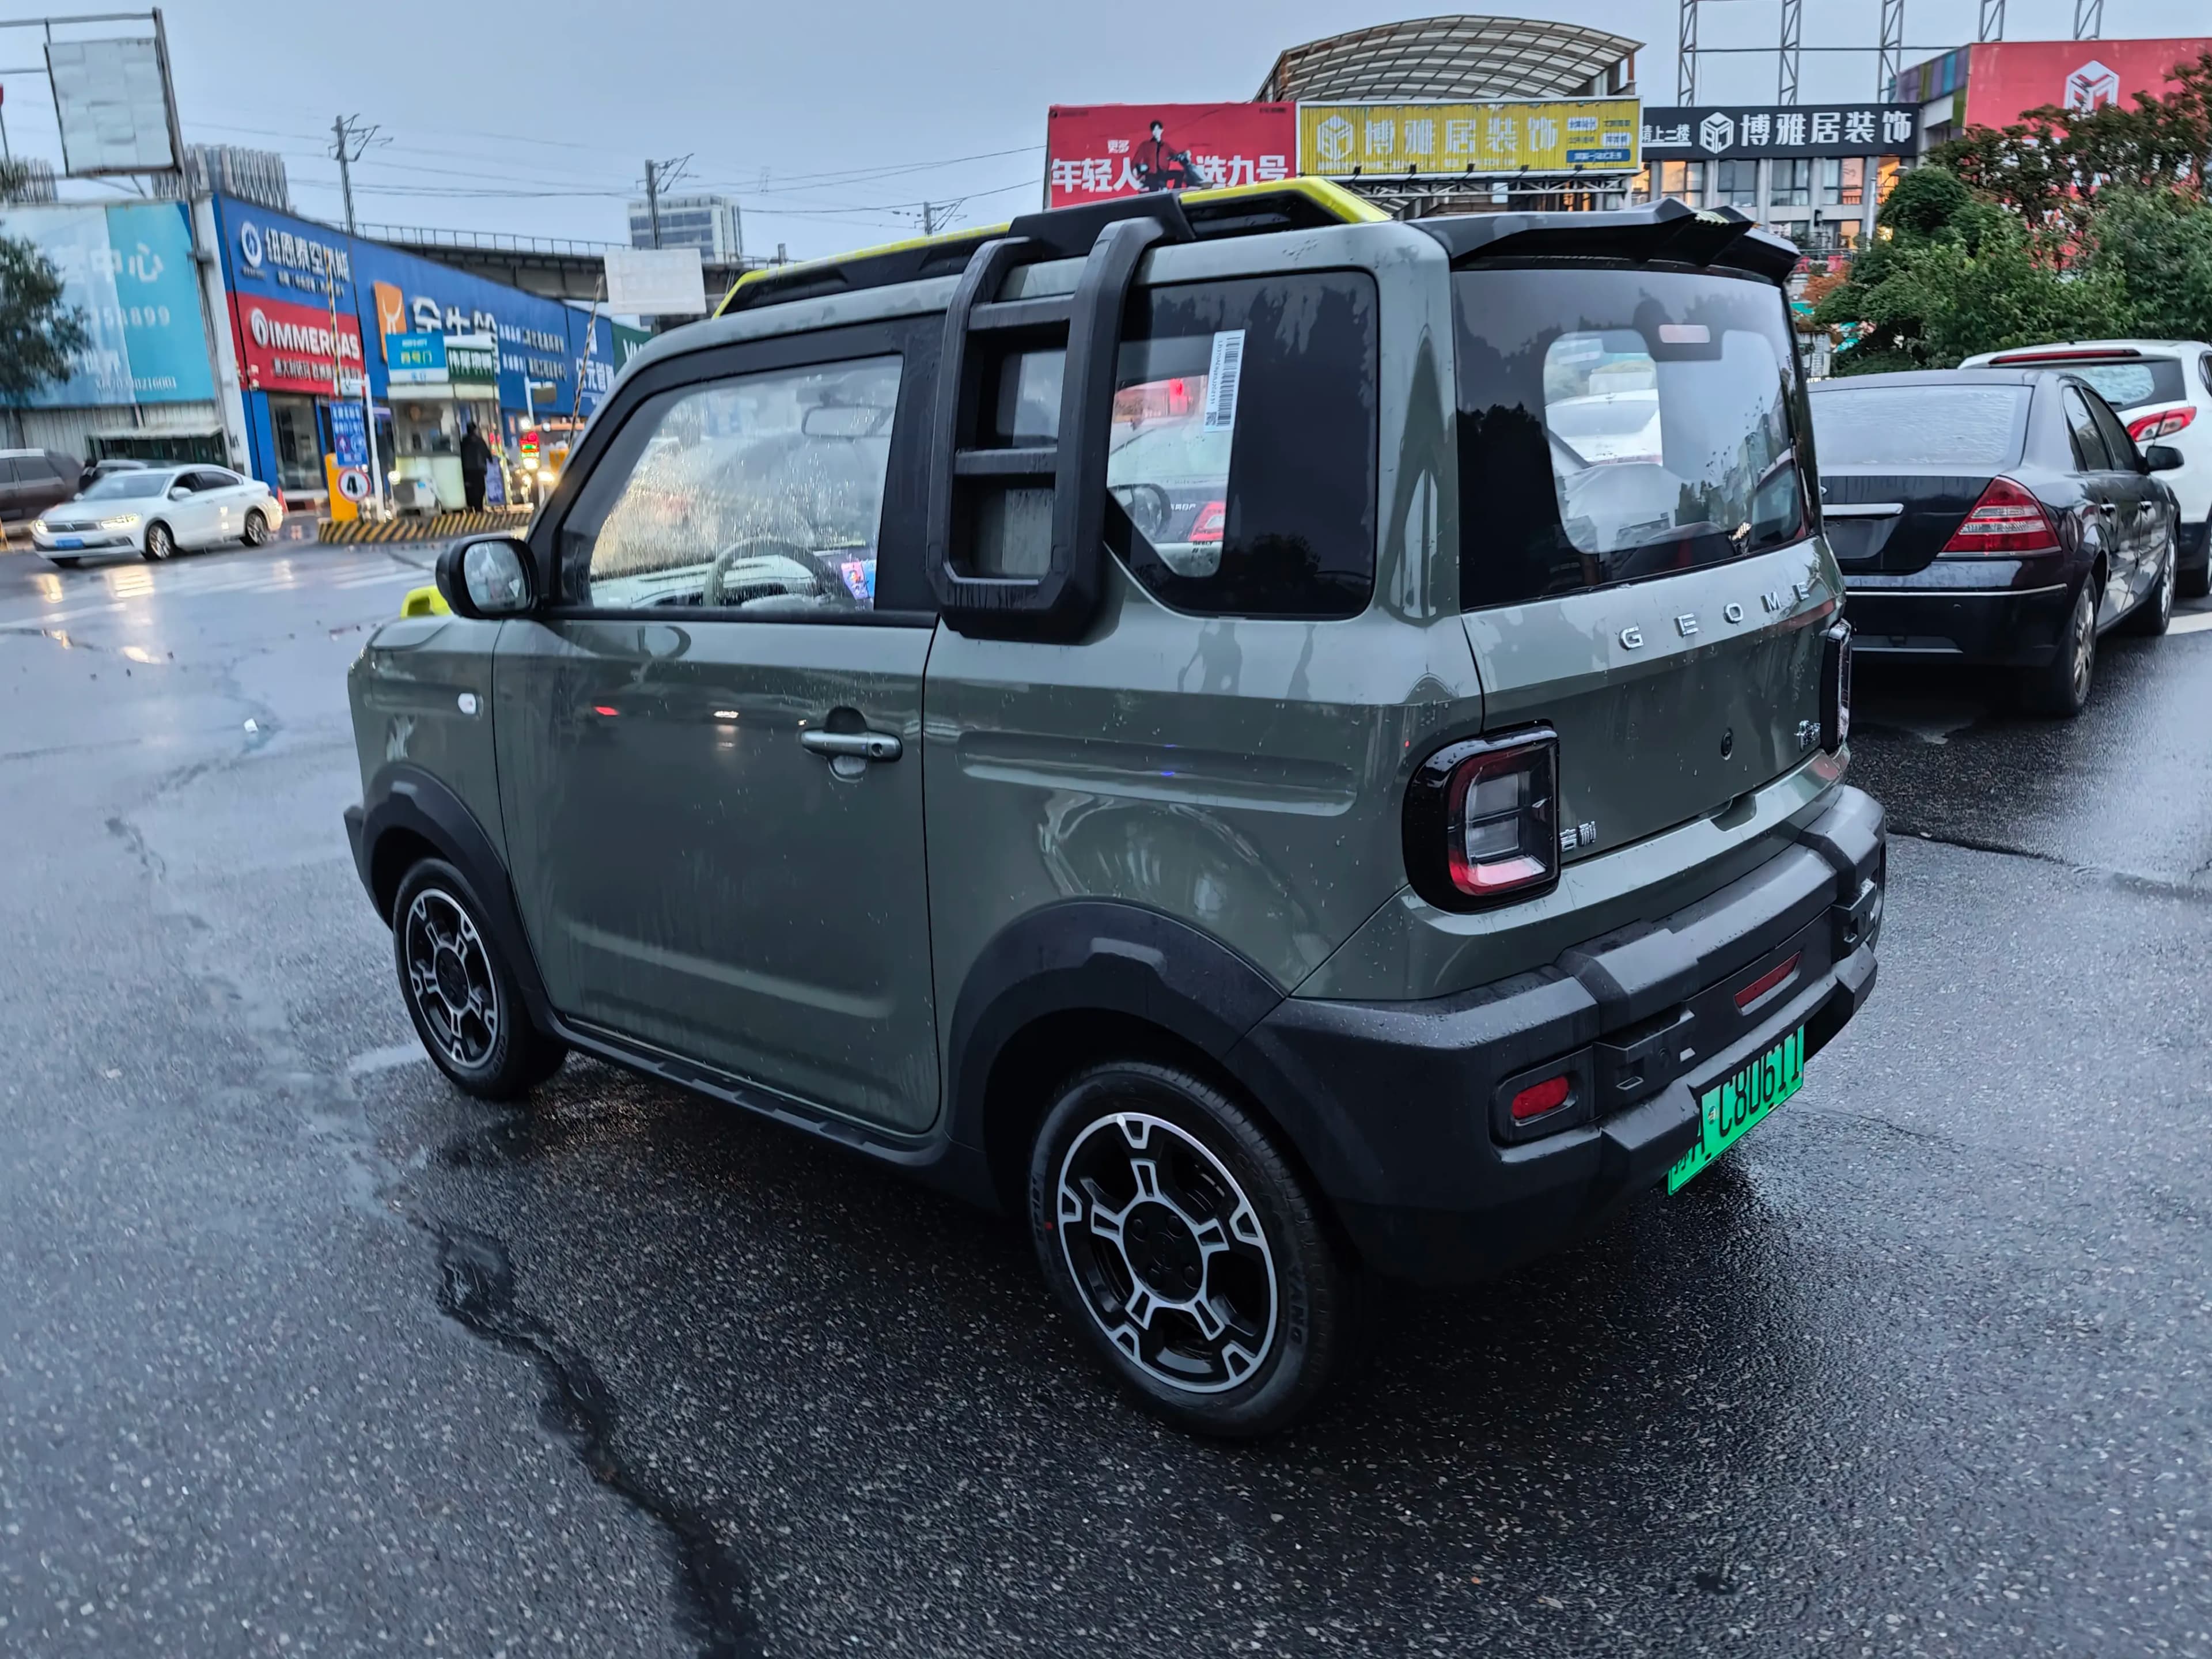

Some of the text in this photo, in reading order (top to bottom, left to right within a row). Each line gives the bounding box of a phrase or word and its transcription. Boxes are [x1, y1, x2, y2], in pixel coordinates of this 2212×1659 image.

[1107, 139, 1130, 154] 更多
[1365, 116, 1558, 156] 博雅居装饰
[1740, 110, 1912, 147] 博雅居装饰
[1051, 157, 1142, 194] 年轻人
[269, 319, 361, 361] IMMERGAS
[1619, 581, 1810, 650] GEOME
